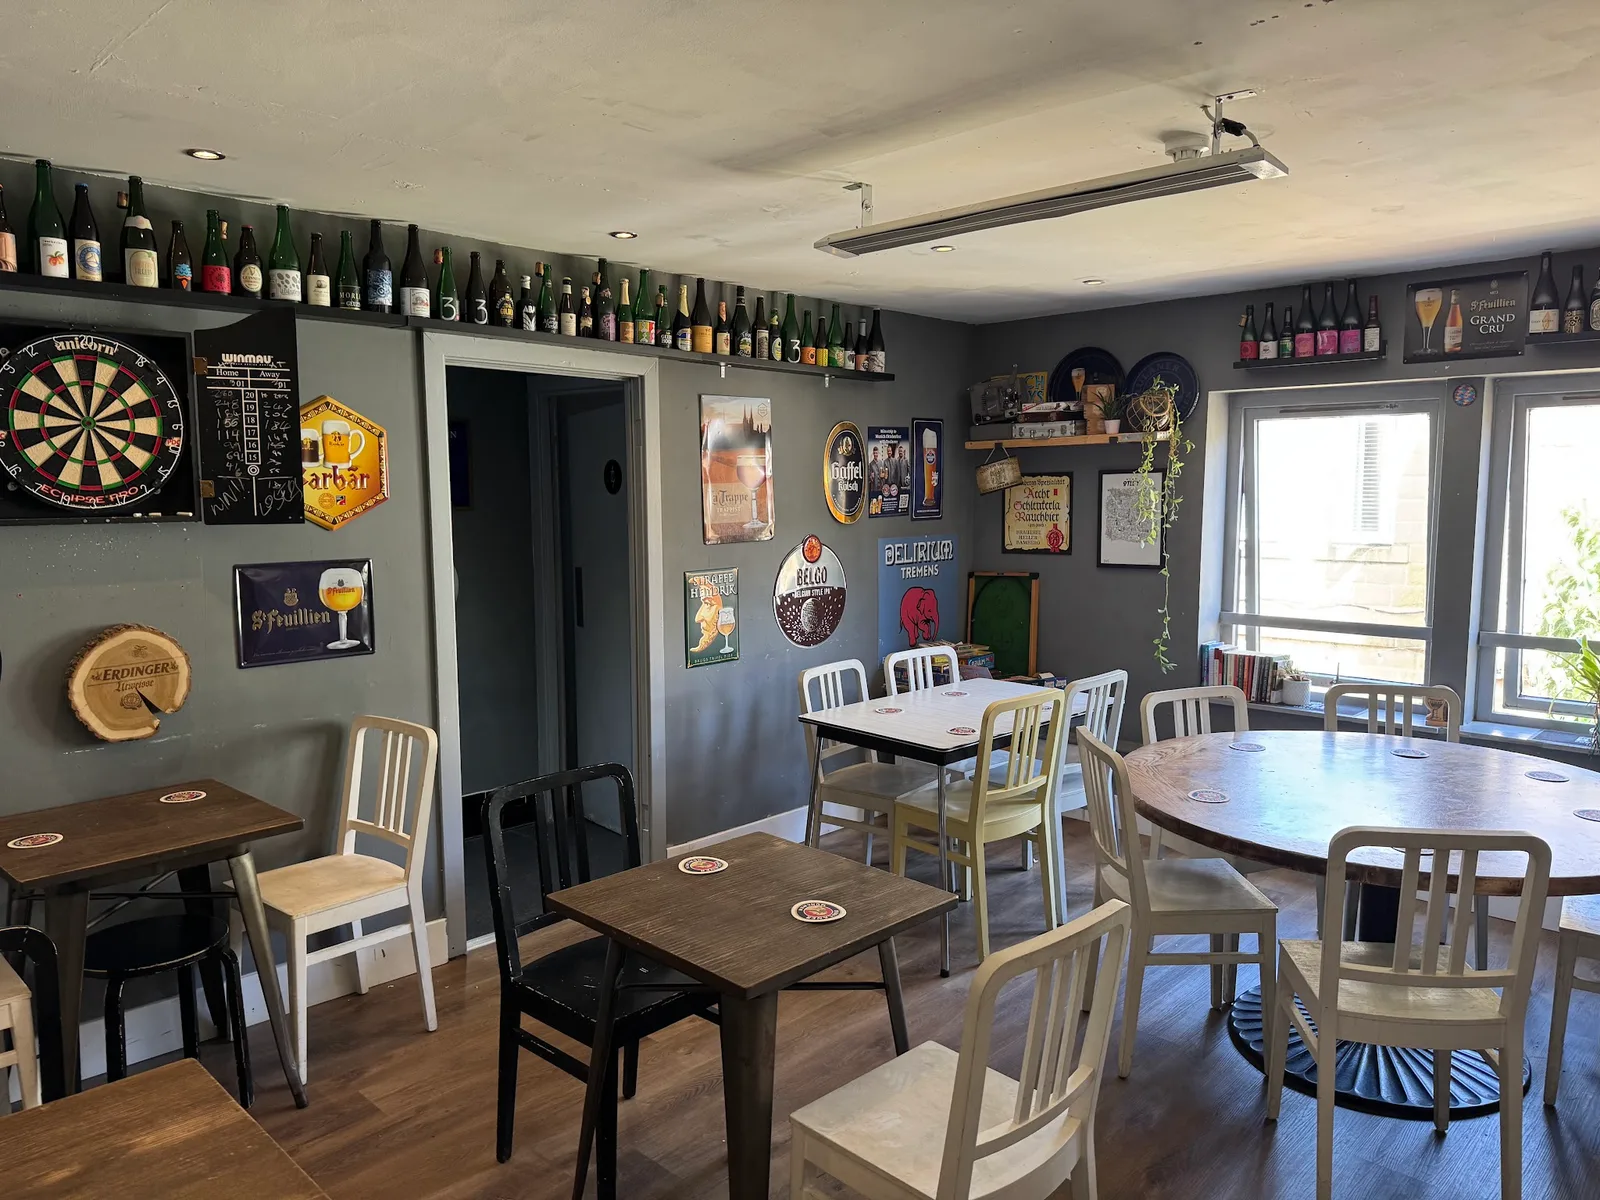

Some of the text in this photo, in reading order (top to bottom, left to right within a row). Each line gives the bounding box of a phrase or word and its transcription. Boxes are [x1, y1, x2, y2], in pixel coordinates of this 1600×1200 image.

[441, 297, 457, 320] 3
[475, 299, 488, 324] 3
[1470, 313, 1516, 325] GRAND
[1479, 324, 1505, 334] CRU
[222, 353, 271, 364] WINMAU
[787, 339, 801, 363] 3
[259, 371, 281, 379] Away
[247, 416, 256, 424] 18
[831, 461, 863, 480] Gaffel
[718, 490, 749, 506] Trappe
[1015, 511, 1060, 524] Rauchbier
[884, 539, 954, 566] DELIRIUM
[796, 566, 828, 586] BELGO
[900, 564, 940, 579] TREMENS
[693, 573, 735, 586] STRAFFE
[690, 584, 738, 599] HENDRIK
[103, 662, 170, 680] ERDINGER
